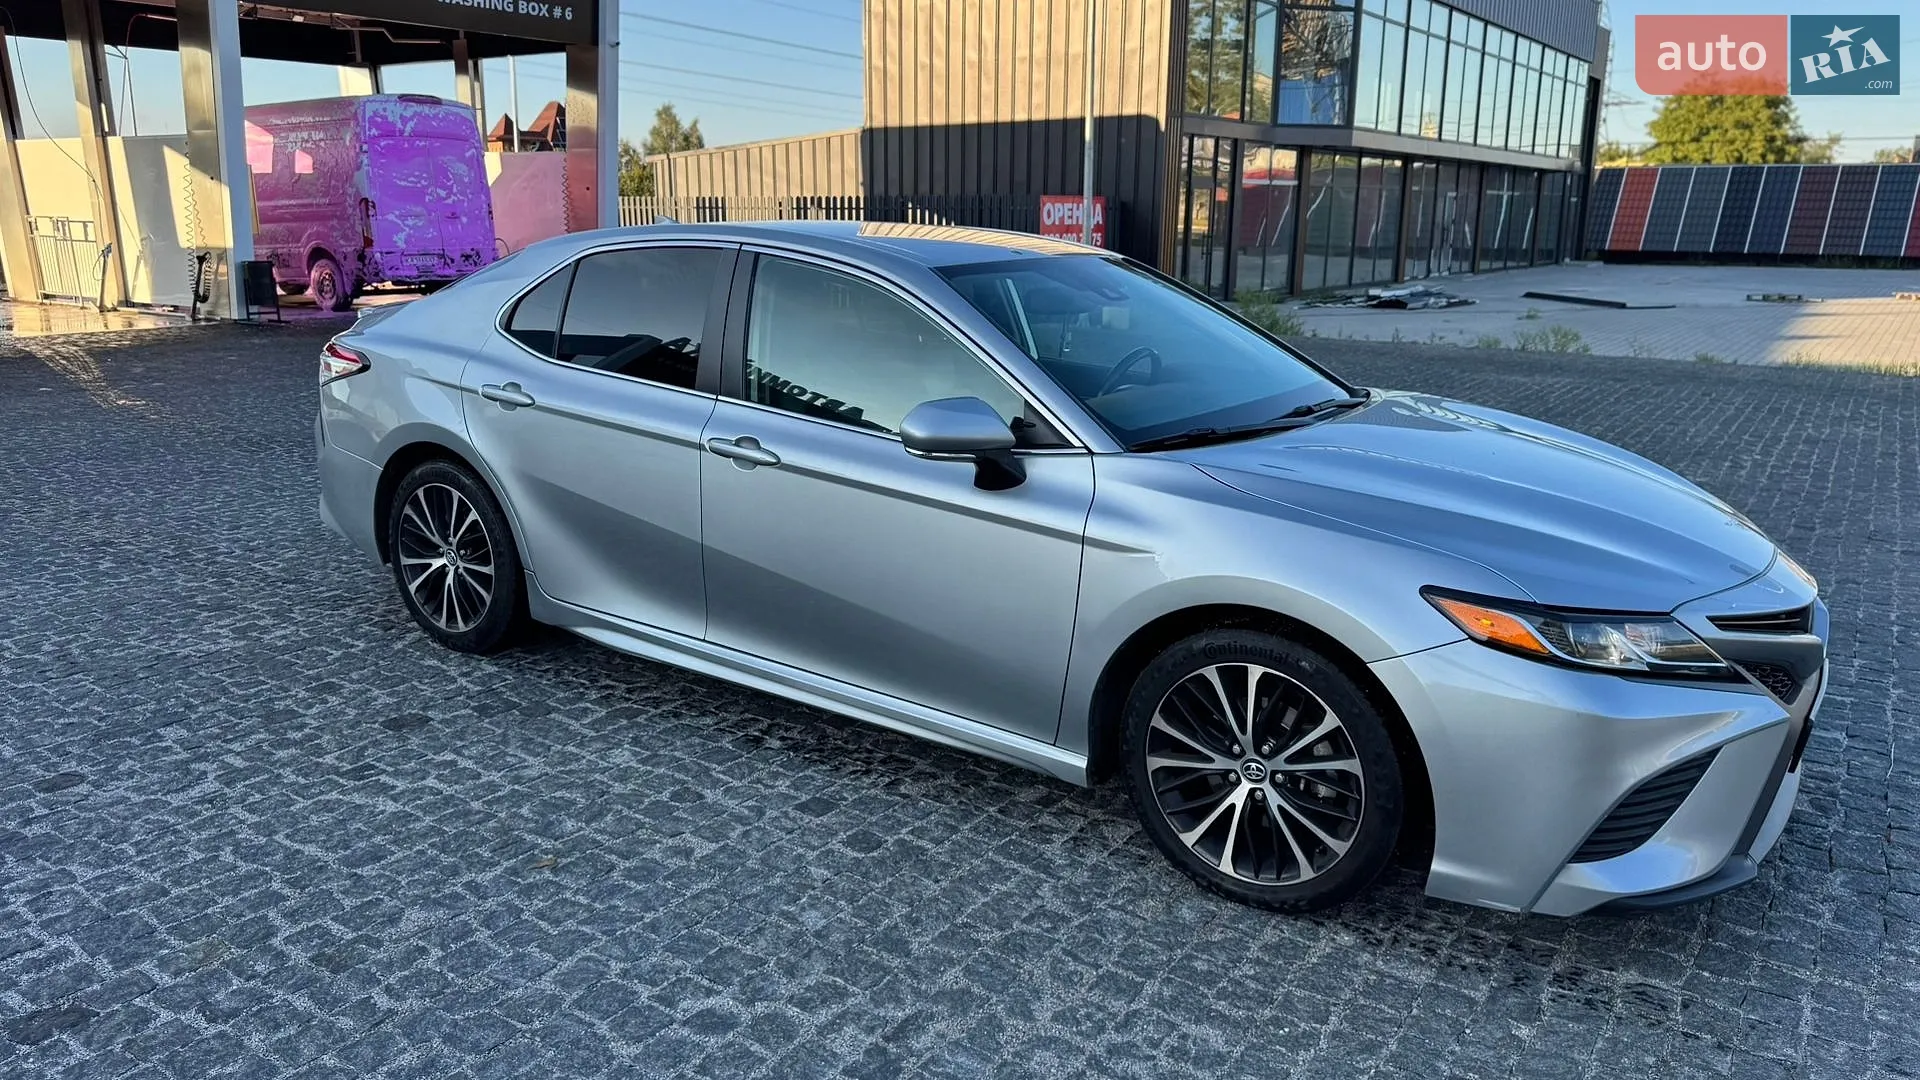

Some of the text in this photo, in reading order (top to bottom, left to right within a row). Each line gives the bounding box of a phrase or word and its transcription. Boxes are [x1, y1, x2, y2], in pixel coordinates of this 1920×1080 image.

[519, 0, 549, 17] BOX
[552, 6, 562, 19] #
[564, 7, 573, 20] 6
[1043, 203, 1103, 227] ОРЕНА
[1203, 640, 1290, 665] Continental
